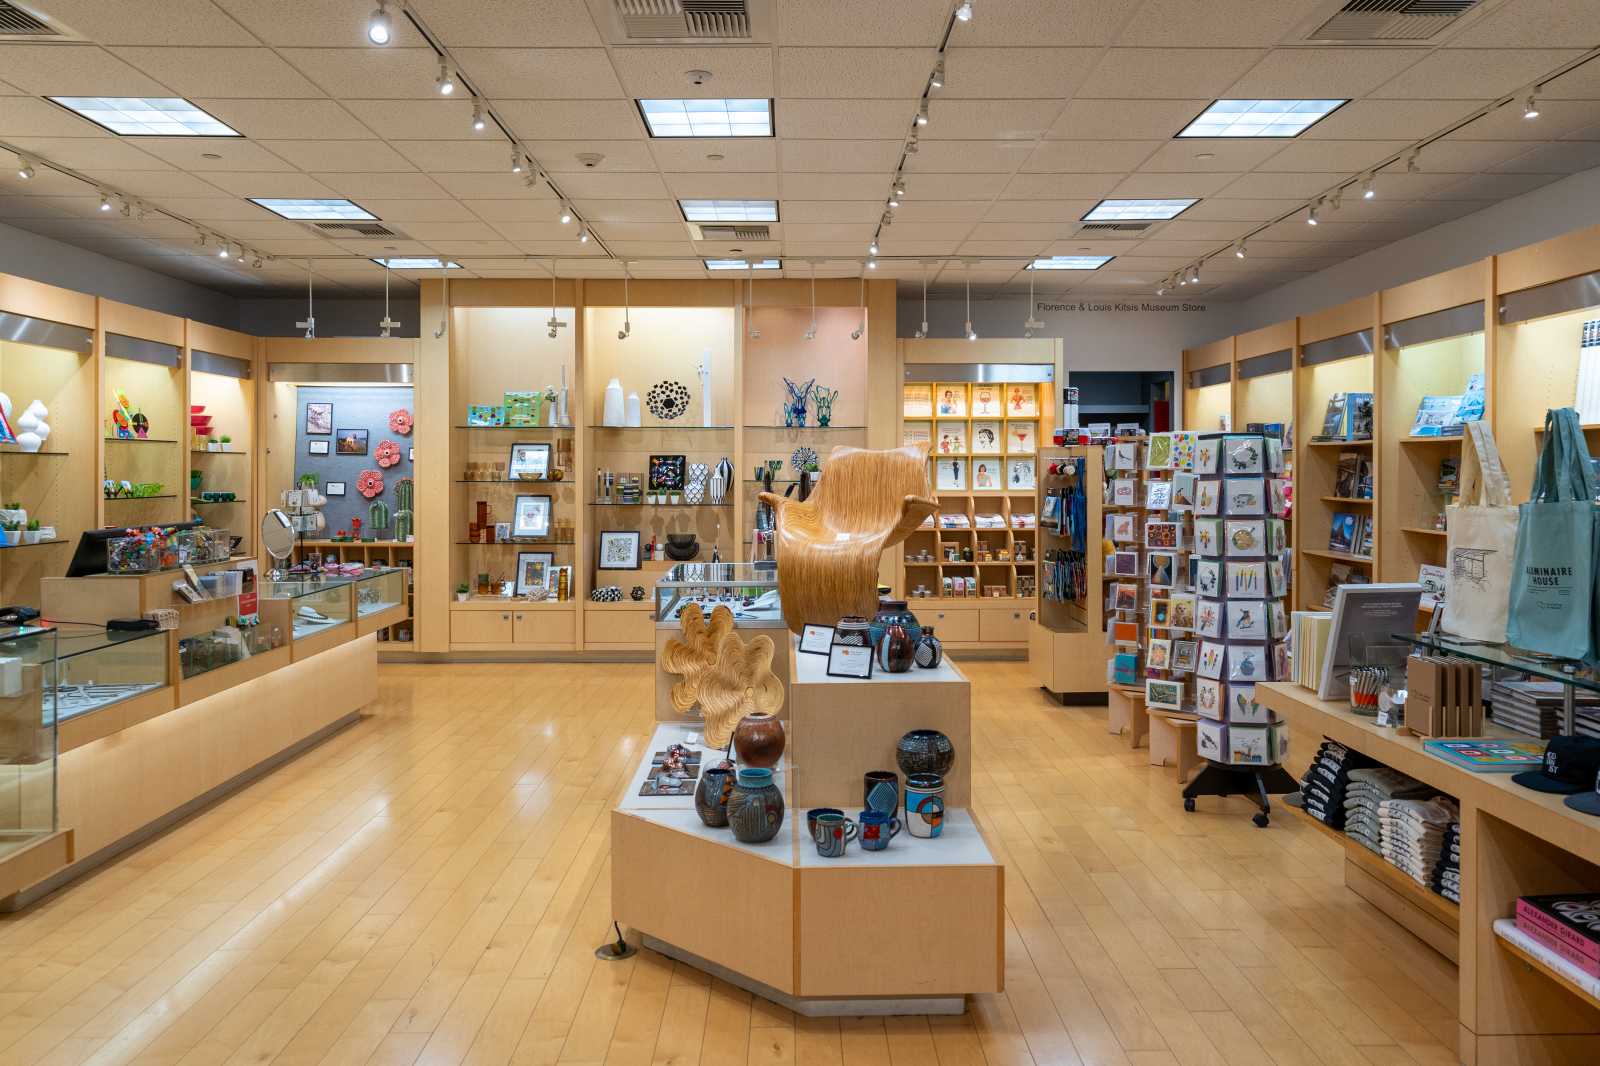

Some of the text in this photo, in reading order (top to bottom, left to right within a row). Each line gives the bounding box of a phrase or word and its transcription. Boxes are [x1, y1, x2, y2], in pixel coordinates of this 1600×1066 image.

[1037, 302, 1076, 312] Florence
[1079, 303, 1086, 312] &
[1088, 303, 1112, 312] Louis
[1141, 303, 1180, 312] Museum
[1182, 303, 1206, 312] Store
[1532, 576, 1560, 586] HOUSE
[1560, 927, 1585, 946] GIRARD
